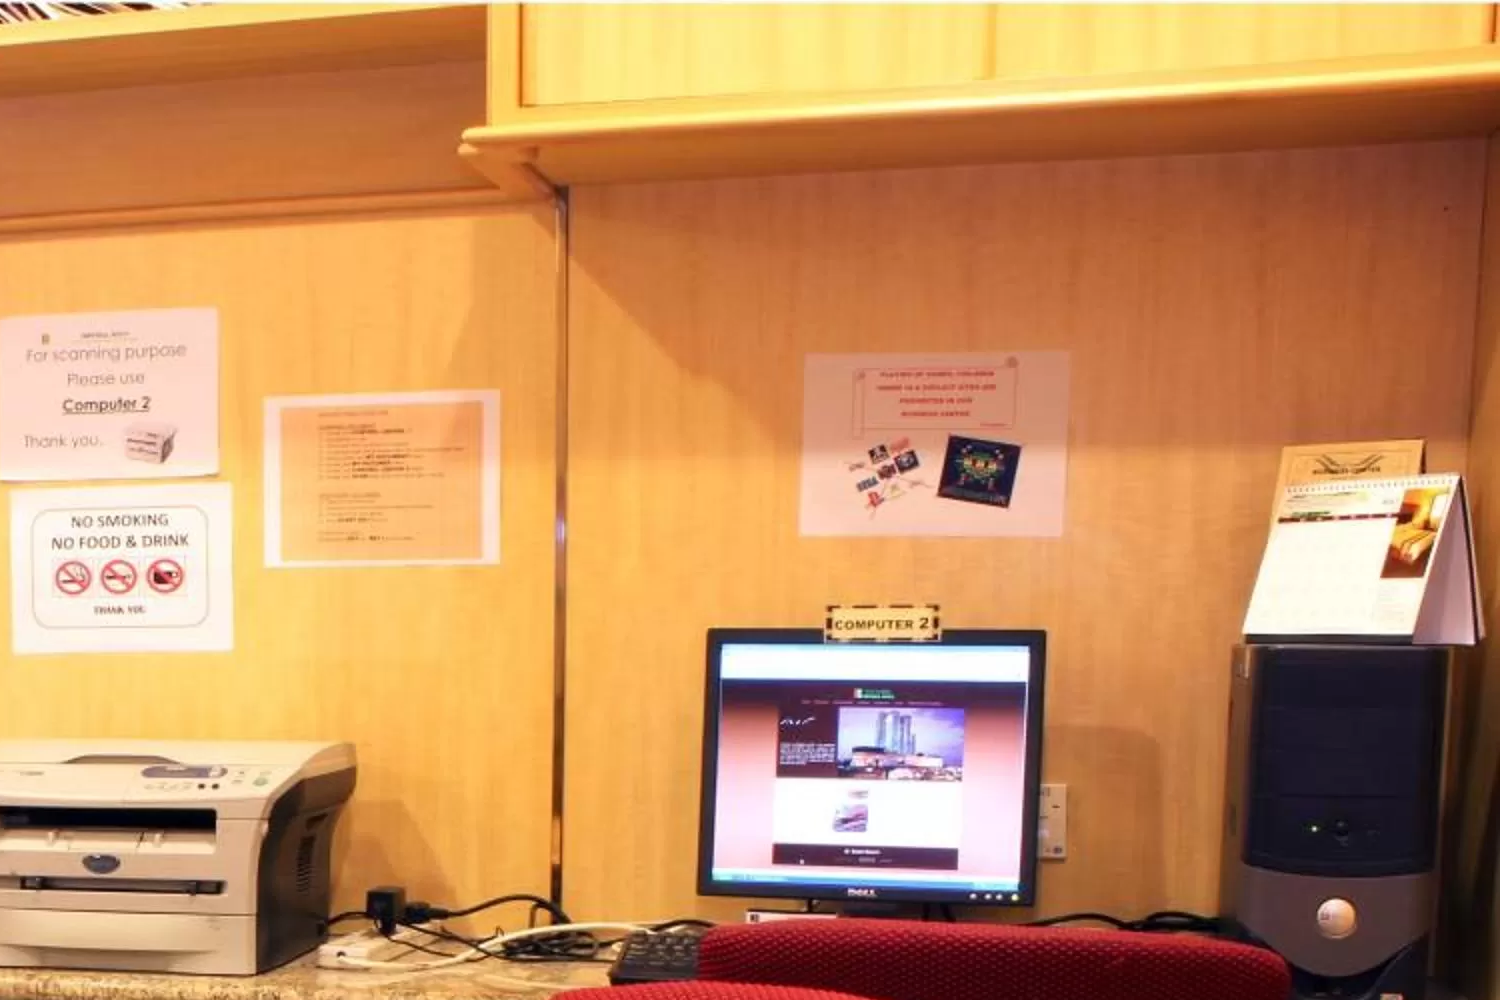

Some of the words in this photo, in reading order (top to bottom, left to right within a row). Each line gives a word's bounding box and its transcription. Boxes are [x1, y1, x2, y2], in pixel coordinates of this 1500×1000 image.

[26, 348, 48, 363] For
[53, 346, 120, 363] scanning
[125, 343, 187, 362] purpose
[67, 371, 115, 387] Please
[120, 373, 145, 385] use
[62, 396, 137, 415] Computer
[142, 396, 152, 412] 2
[24, 434, 67, 449] Thank
[71, 515, 93, 528] NO
[97, 513, 169, 528] SMOKING
[51, 537, 75, 550] NO
[79, 535, 121, 549] FOOD
[125, 535, 137, 548] &
[142, 533, 190, 547] DRINK
[835, 619, 914, 630] COMPUTER
[919, 617, 929, 629] 2
